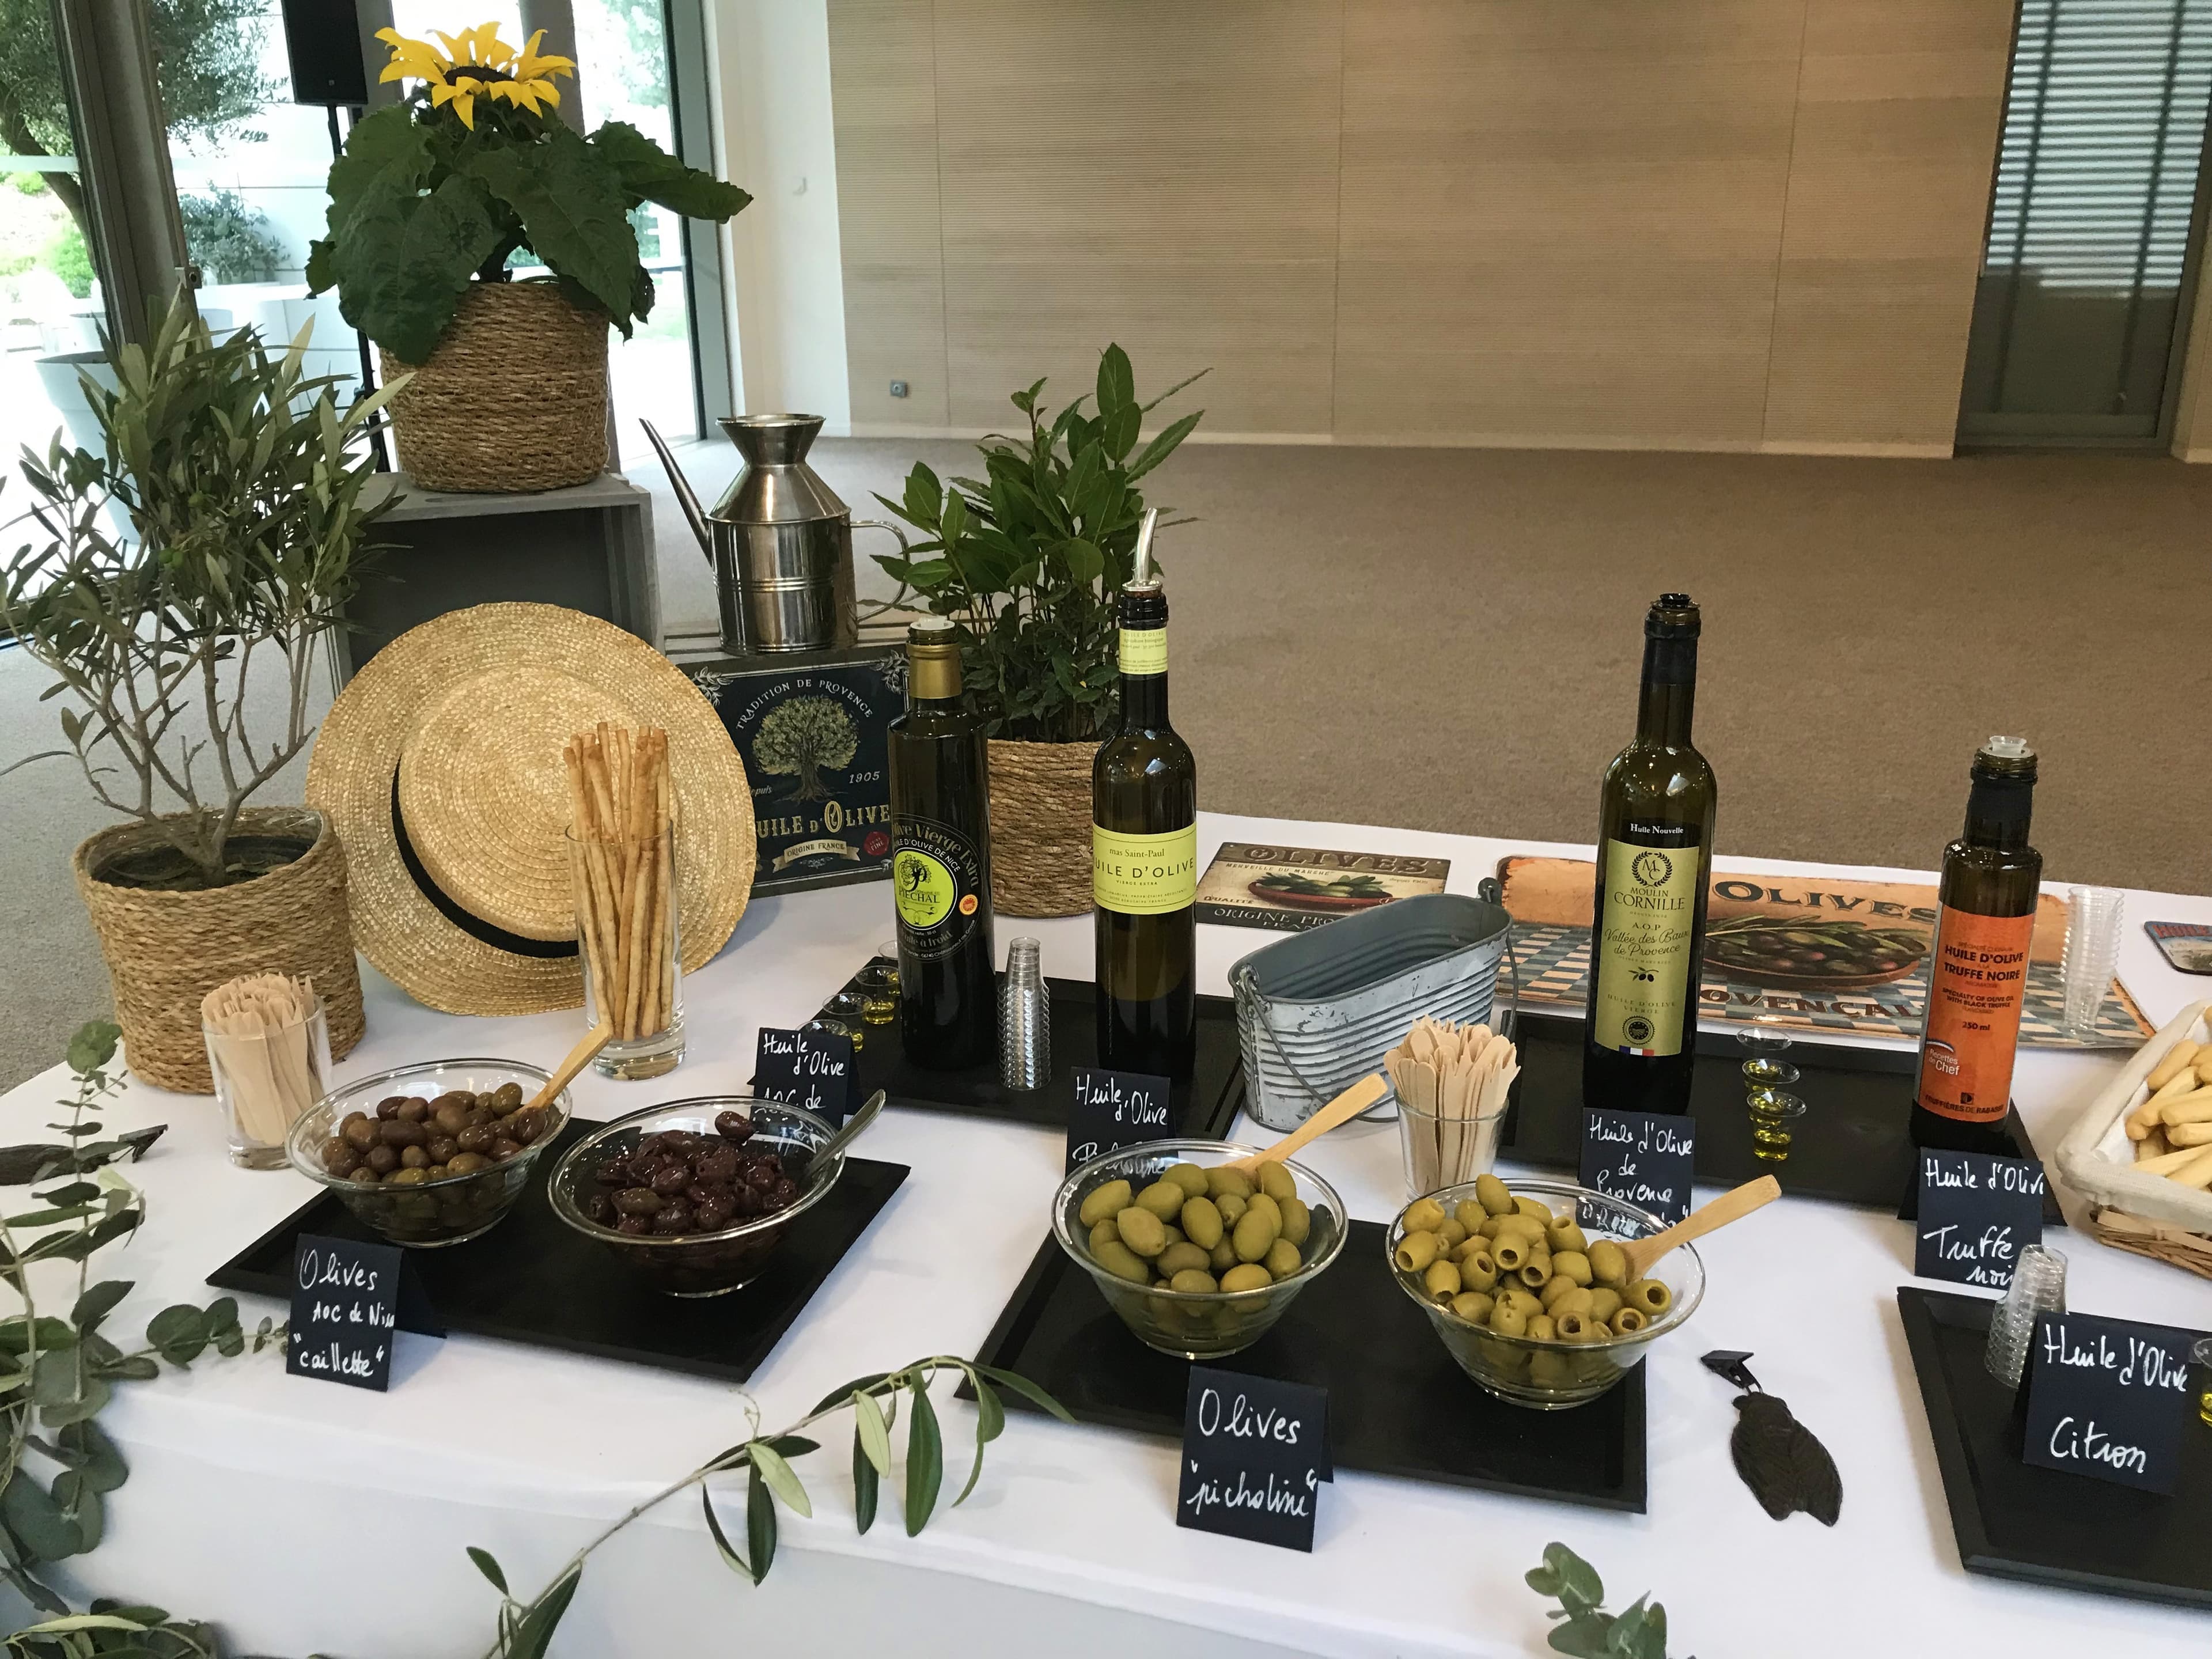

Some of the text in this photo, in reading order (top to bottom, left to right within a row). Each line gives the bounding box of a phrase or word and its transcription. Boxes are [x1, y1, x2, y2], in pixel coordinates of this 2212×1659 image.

[736, 679, 873, 730] TRADITION DE PROVENCE
[849, 771, 881, 783] 1905
[750, 785, 772, 797] epuis
[756, 816, 803, 838] UILE
[1630, 823, 1684, 834] Huile Nouvelle
[787, 842, 845, 857] ORIGINE FRANCE
[893, 823, 979, 888] live Vierge Extra
[904, 839, 934, 851] D'OLIVE
[934, 849, 946, 858] DE
[945, 855, 961, 872] NICE
[1125, 849, 1165, 858] Saint-Paul
[1244, 847, 1429, 874] OLIVES
[1095, 857, 1194, 878] UILE D'OLIVE
[1226, 863, 1274, 871] MERVEILLE
[1614, 891, 1685, 911] CORNILLE
[1630, 887, 1668, 897] MOULIN
[1712, 880, 1936, 924] OLIVES
[1214, 908, 1334, 925] ORIGINE PRO
[1604, 928, 1690, 944] Vallée des Baux
[1613, 943, 1681, 956] de Provence
[1945, 944, 2024, 964] HUILE D'OLIVE
[1944, 961, 2020, 981] TRUFFE NOIRE
[1941, 987, 1974, 999] SPECIALTY
[1947, 995, 1962, 1003] WITH
[1963, 1000, 1986, 1008] BLACK
[1962, 1021, 1978, 1030] 250
[764, 1033, 808, 1055] Huile
[793, 1051, 845, 1075] d'Olive
[1930, 1048, 1958, 1065] Recettes
[1936, 1060, 1960, 1075] Chef
[805, 1084, 826, 1109] de
[1076, 1074, 1122, 1105] Huile
[1115, 1091, 1167, 1125] d'Olive
[1589, 1114, 1692, 1156] Huile d'Olive
[1618, 1153, 1638, 1176] de
[1925, 1158, 1978, 1188] Huile
[1923, 1225, 2014, 1260] Truffe
[300, 1248, 378, 1291] Olives
[312, 1301, 342, 1323] AOC
[349, 1301, 363, 1322] de
[2044, 1324, 2188, 1392] Huile d'Olive
[1199, 1388, 1301, 1444] Olives
[2050, 1416, 2146, 1474] Citron
